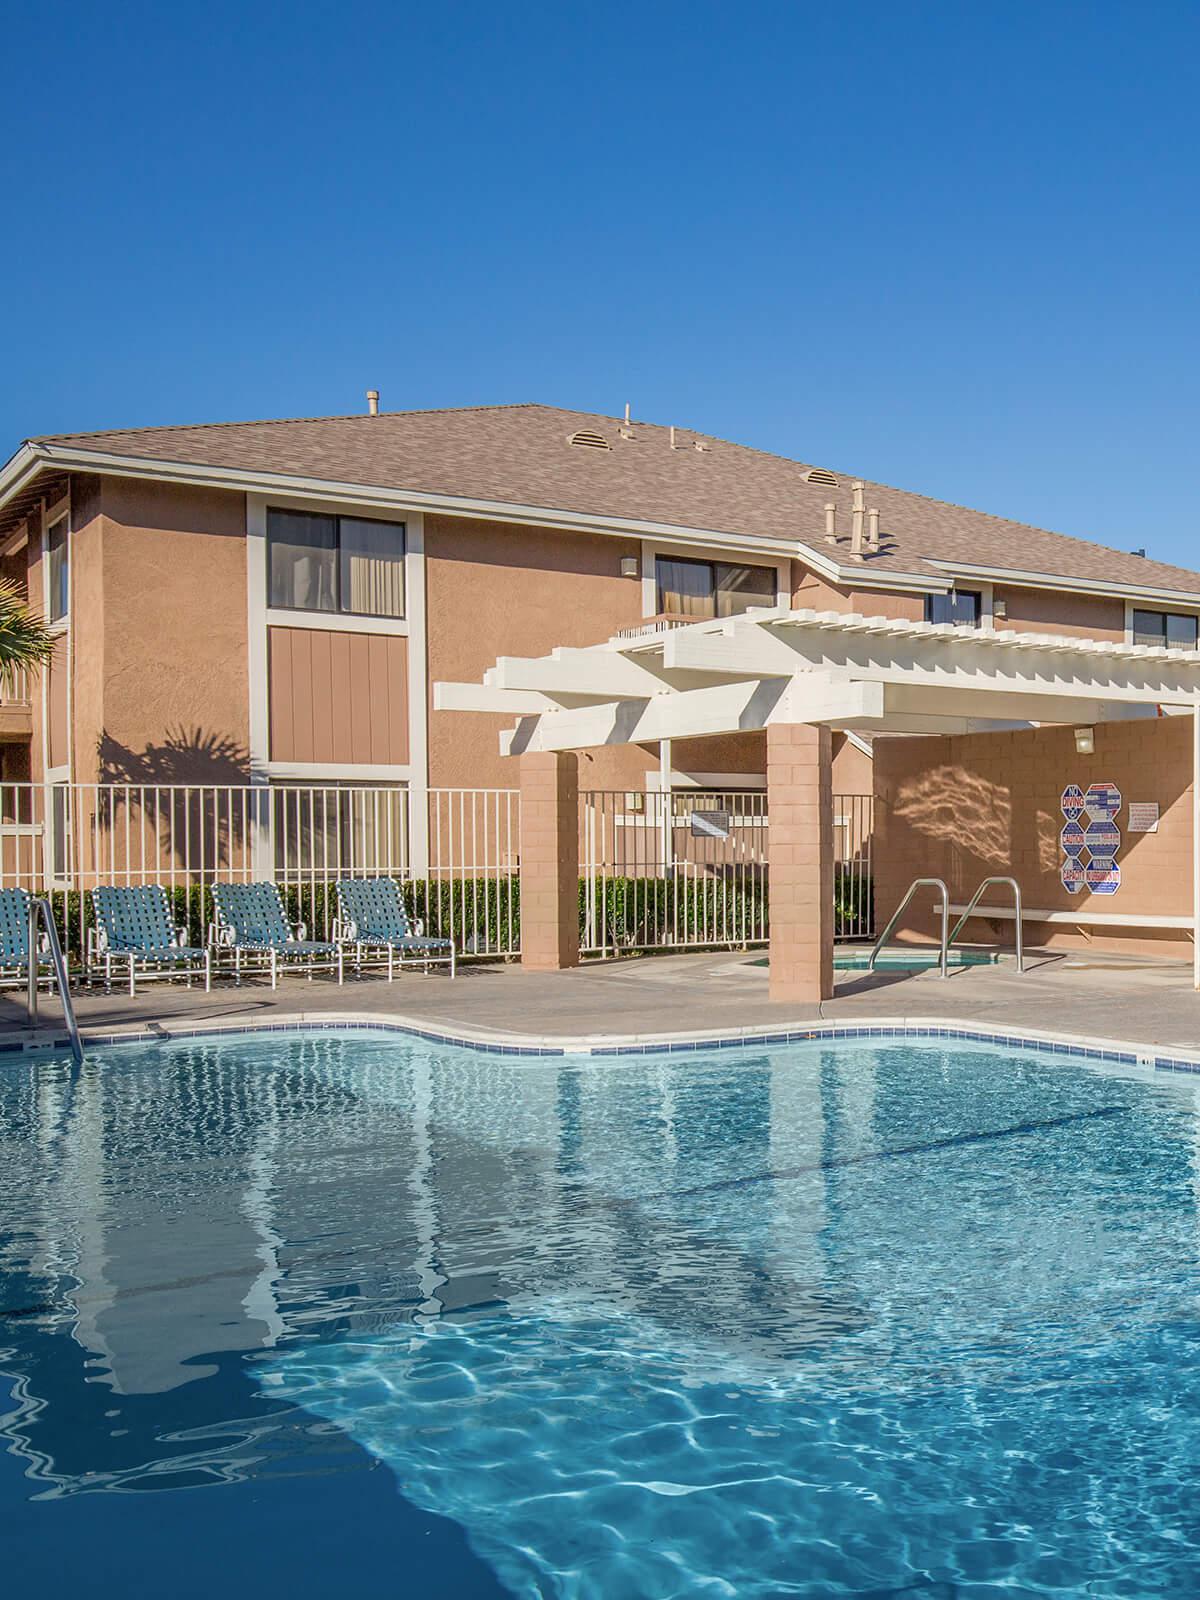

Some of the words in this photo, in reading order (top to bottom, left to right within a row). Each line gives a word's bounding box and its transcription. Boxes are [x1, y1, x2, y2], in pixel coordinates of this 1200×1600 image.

[1069, 787, 1078, 797] NO
[1063, 797, 1084, 807] DIVING
[1063, 834, 1084, 844] CAUTION
[1063, 870, 1085, 881] CAPACITY
